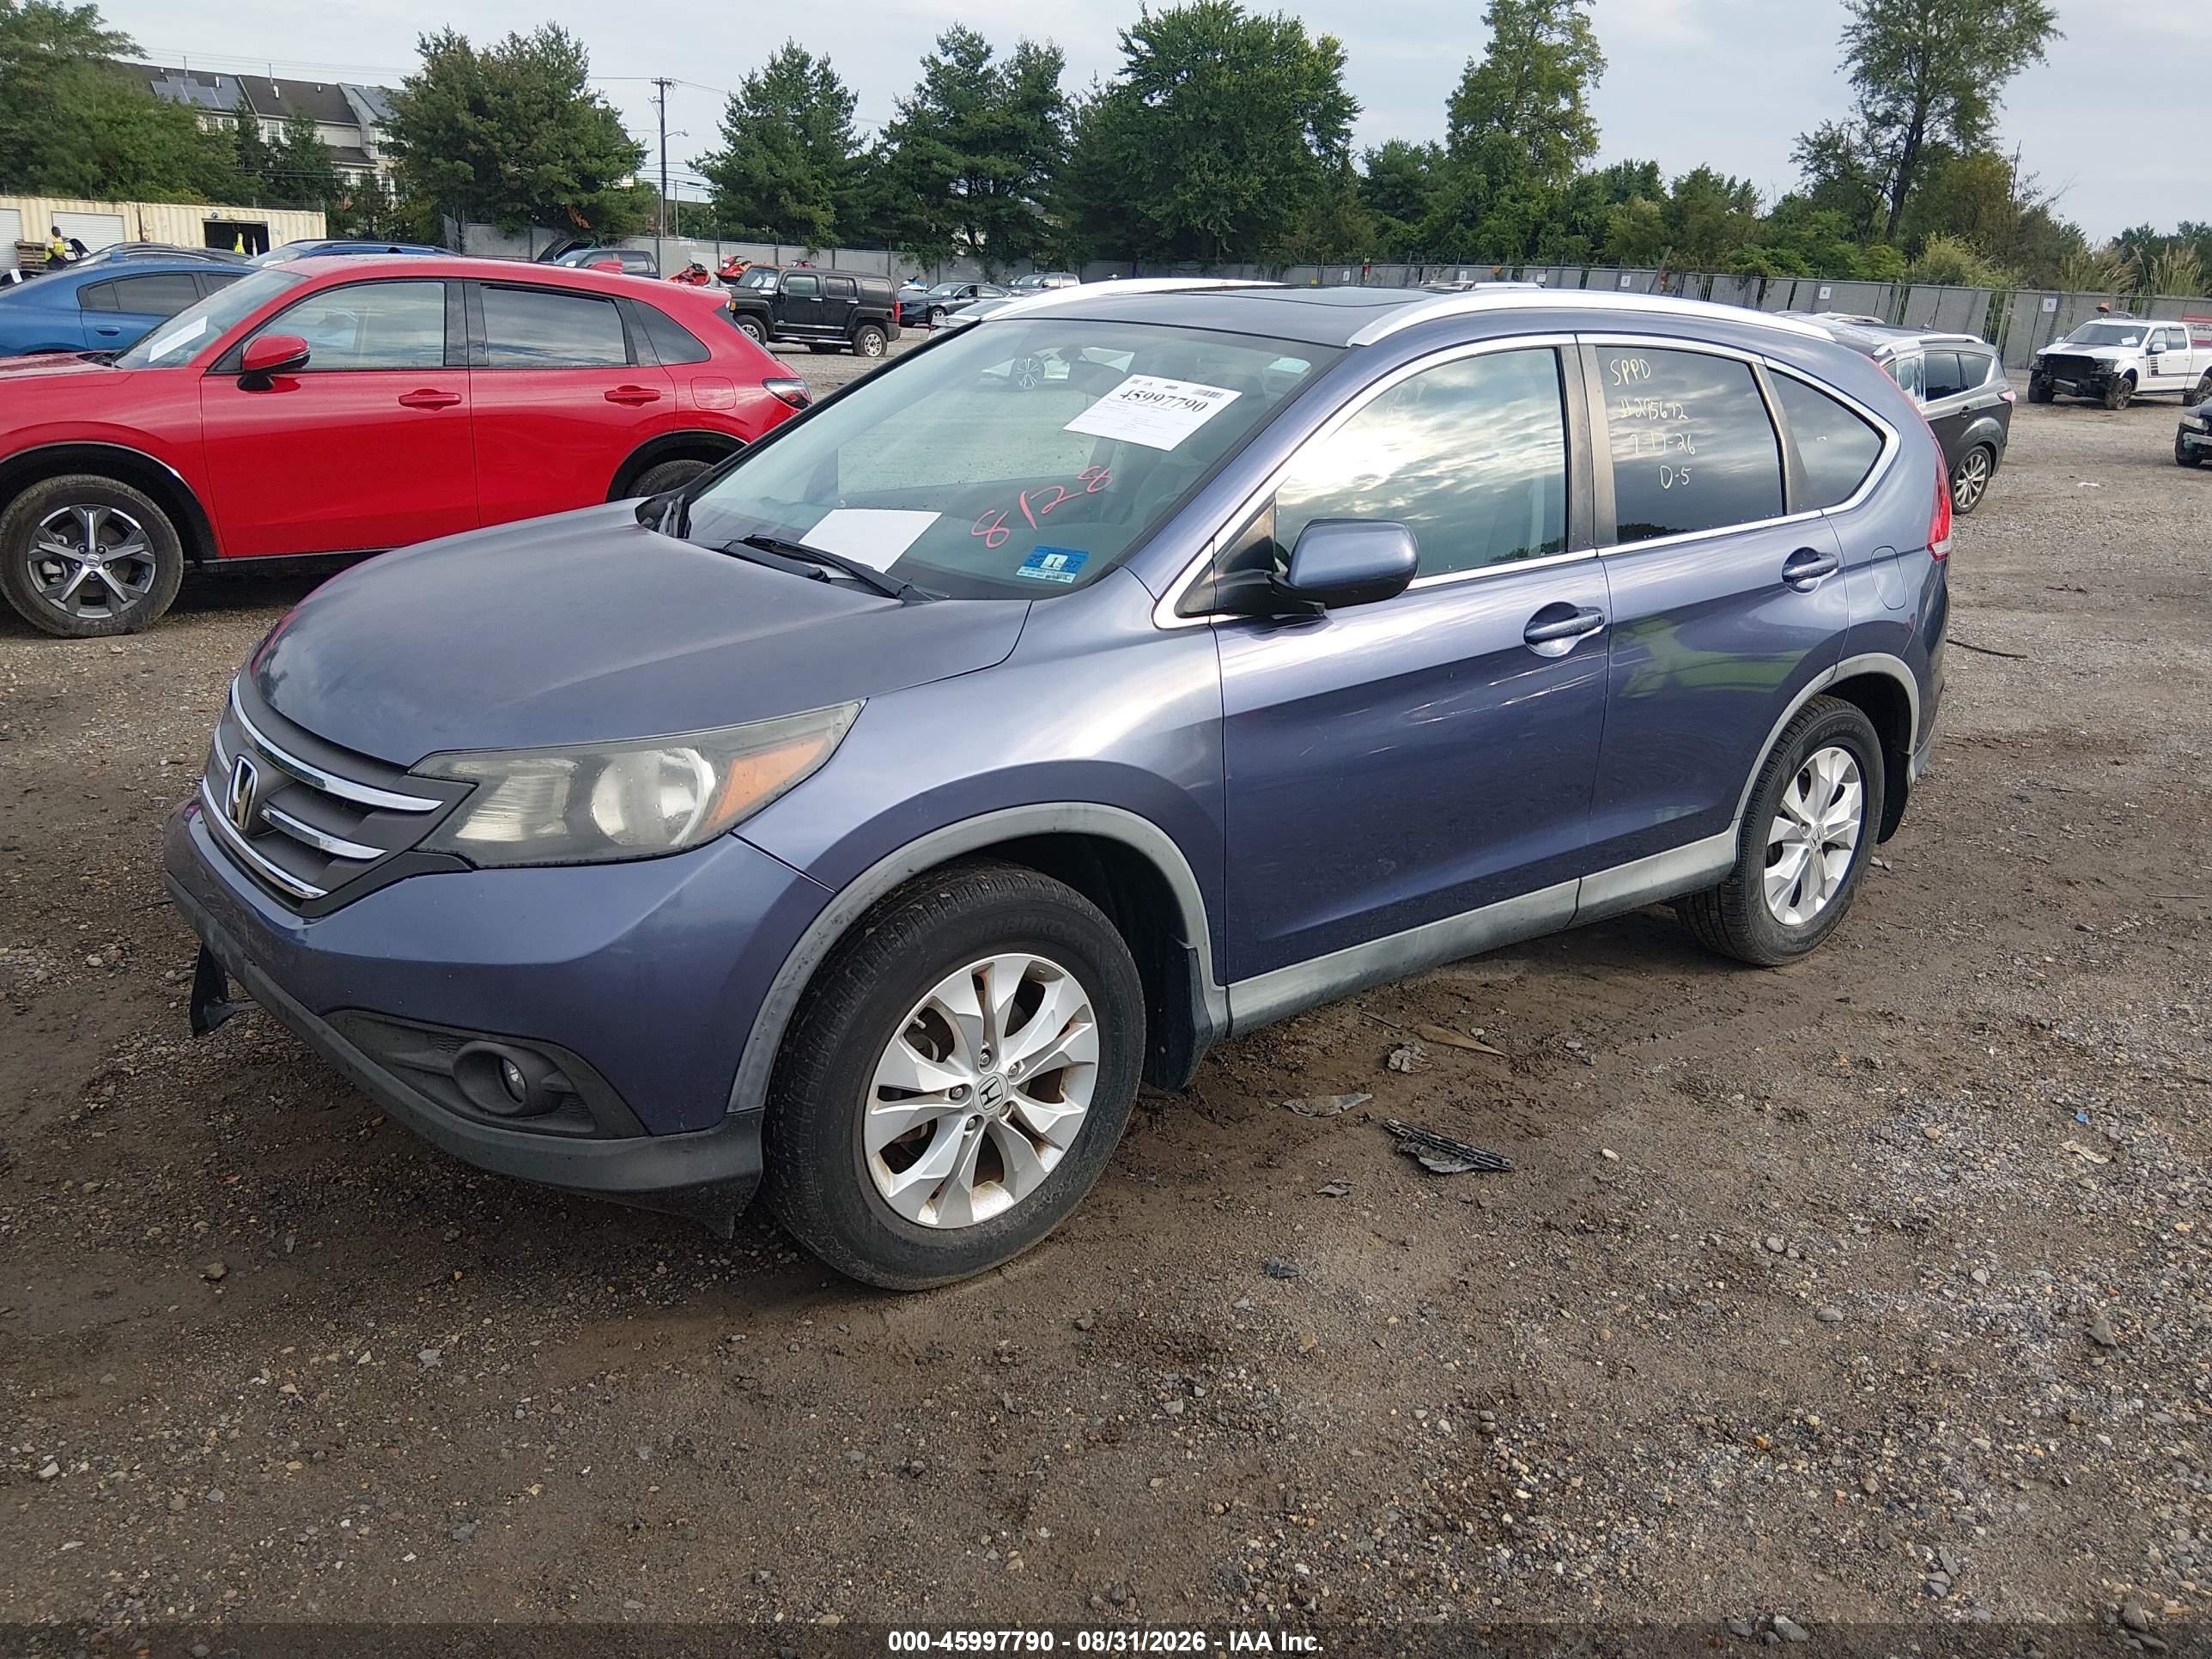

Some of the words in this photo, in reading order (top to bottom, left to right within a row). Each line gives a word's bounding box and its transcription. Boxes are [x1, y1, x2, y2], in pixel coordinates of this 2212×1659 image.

[1610, 358, 1651, 386] SPPD
[1119, 389, 1208, 413] 45997790
[1659, 465, 1692, 489] D-5
